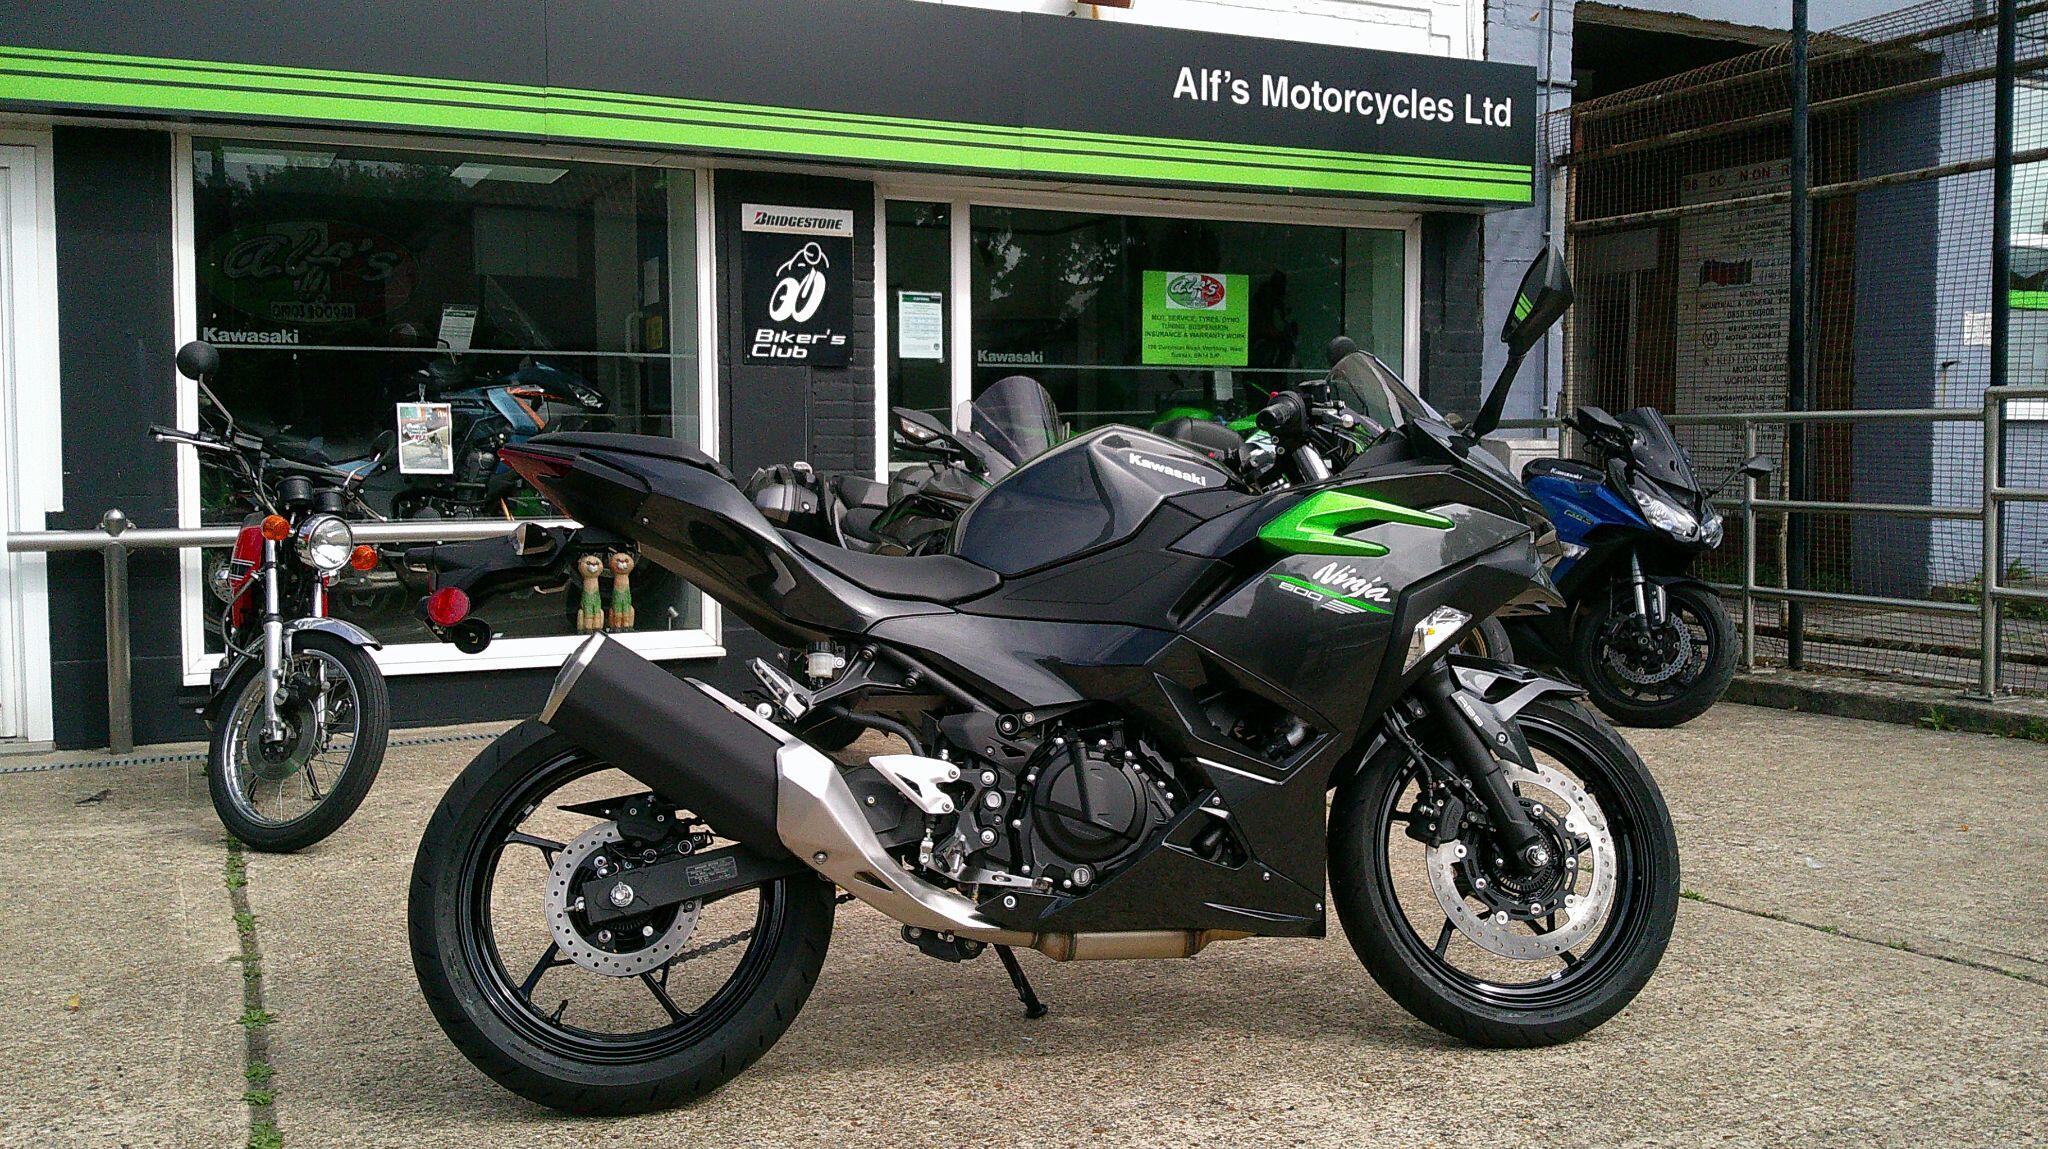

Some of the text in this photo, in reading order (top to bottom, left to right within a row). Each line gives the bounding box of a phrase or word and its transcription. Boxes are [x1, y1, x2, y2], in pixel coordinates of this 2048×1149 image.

[1173, 66, 1512, 128] Alf's Motorcycles Ltd
[753, 211, 844, 230] BRIDGESTONE
[203, 326, 299, 344] Kawasaki
[754, 328, 847, 346] Biker's
[751, 343, 808, 359] Club
[977, 350, 1044, 363] Kawasaki
[1129, 452, 1207, 487] Kawasaki
[1279, 581, 1324, 601] 500
[1312, 561, 1391, 602] Ninja
[1458, 695, 1484, 727] ABS
